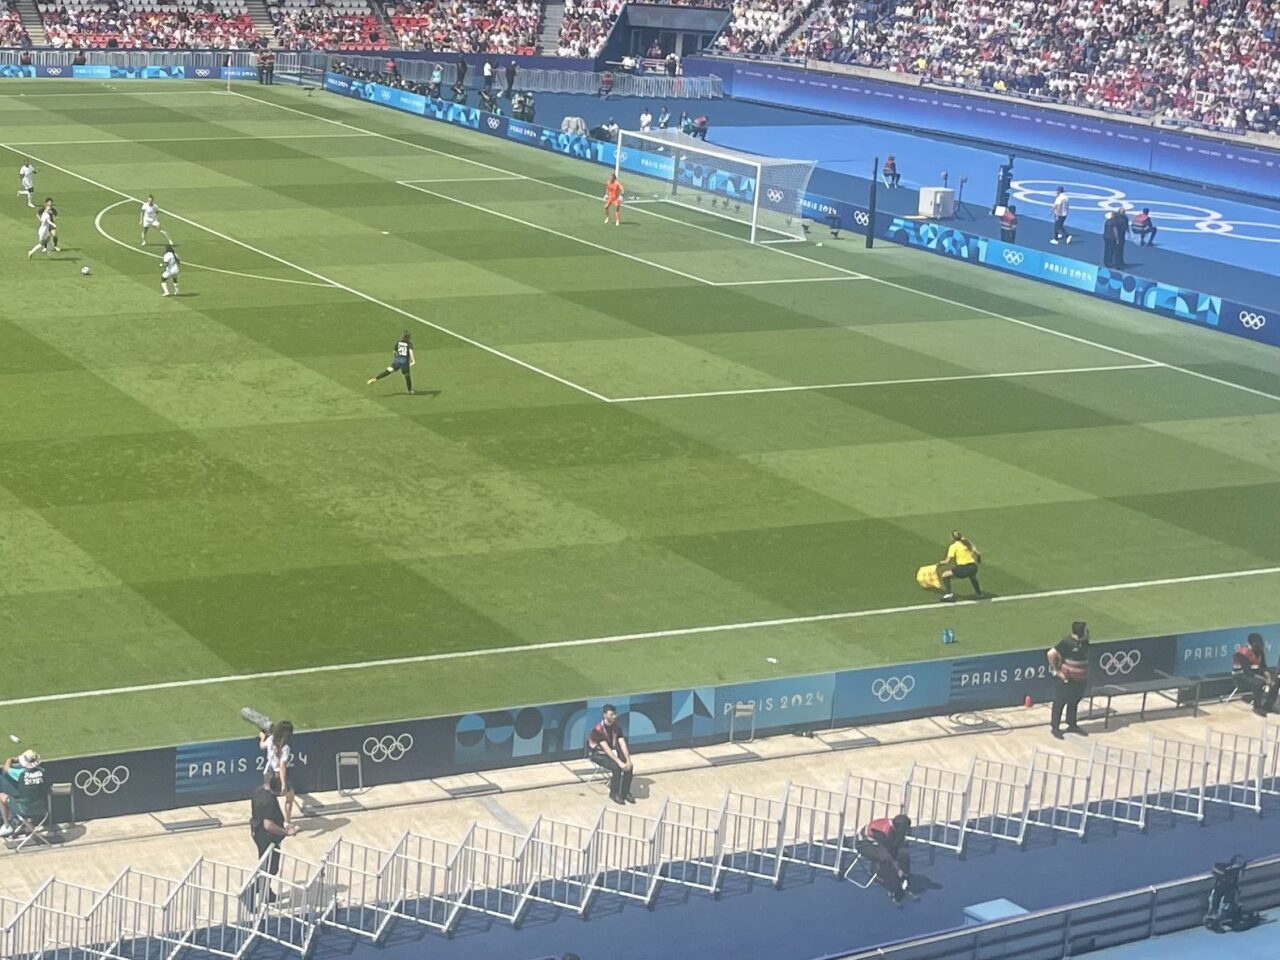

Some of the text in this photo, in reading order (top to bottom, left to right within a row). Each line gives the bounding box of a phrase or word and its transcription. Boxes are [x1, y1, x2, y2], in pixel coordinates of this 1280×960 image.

[1043, 261, 1092, 281] PARIS 2024
[961, 669, 1008, 687] PARIS
[780, 692, 824, 709] 2024
[188, 751, 308, 778] PARIS 224
